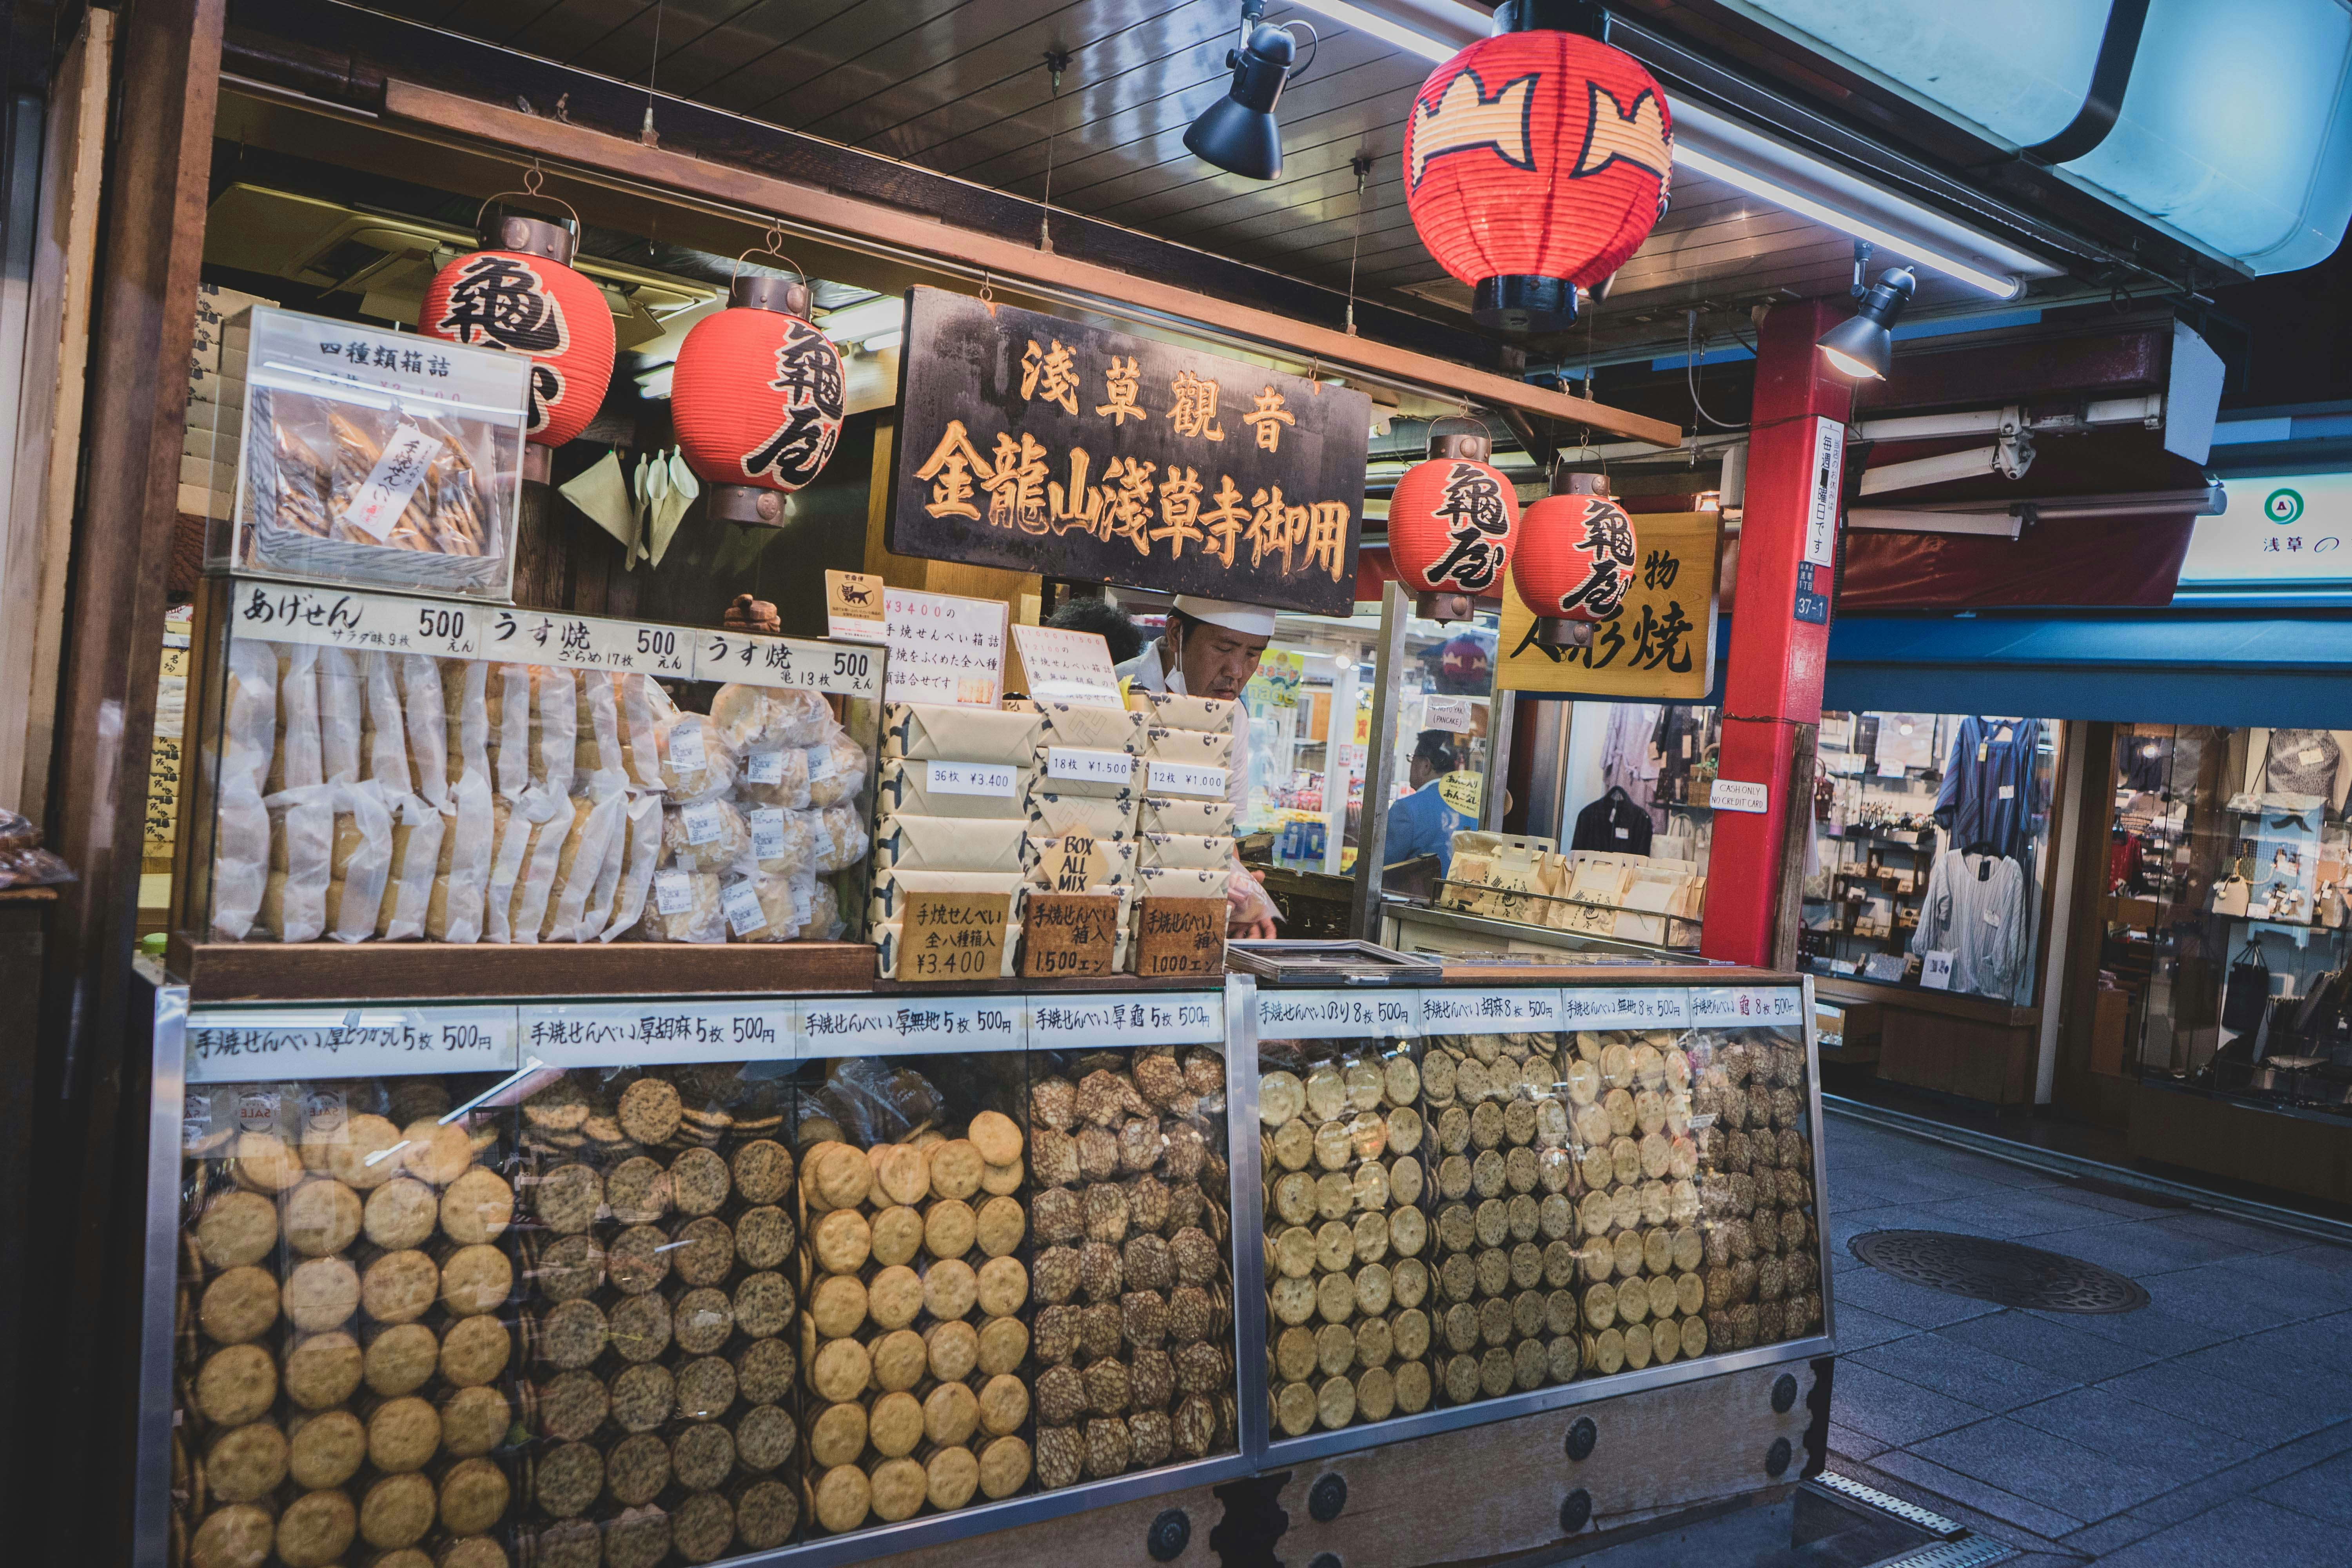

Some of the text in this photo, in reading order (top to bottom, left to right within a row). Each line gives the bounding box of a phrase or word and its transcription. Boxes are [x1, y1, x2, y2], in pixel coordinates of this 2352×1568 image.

[320, 341, 451, 377] 四種類箱詰
[914, 419, 1350, 583] 金龍山淺草寺御用
[1799, 580, 1813, 591] 1丁目
[243, 588, 464, 638] あげせん 500
[886, 600, 955, 618] ¥3400の
[1798, 597, 1823, 617] 37-1
[494, 613, 675, 657] うす焼 500
[886, 623, 1000, 648] 手焼せんべい箱詰
[446, 639, 475, 653] えん
[657, 654, 682, 670] えん
[709, 636, 869, 677] うす焼 500
[1029, 656, 1112, 674] 手焼せんべい箱詰
[852, 677, 873, 690] えん
[1433, 714, 1462, 727] (PANCAKE)
[1054, 758, 1078, 770] 18枚
[935, 770, 960, 782] 36枚
[1154, 772, 1176, 784] 12枚
[1720, 784, 1760, 796] CASH ONLY
[1722, 797, 1747, 806] CREDIT
[1748, 799, 1763, 808] CARD
[1064, 836, 1095, 856] BOX
[1060, 857, 1088, 875] ALL
[1058, 875, 1088, 892] MIX
[916, 903, 1001, 926] 手焼せんべい
[1033, 903, 1116, 928] 手焼せんべい
[1146, 909, 1212, 935] 手焼せんべい
[925, 929, 996, 948] 全八種箱入
[1071, 925, 1110, 945] 箱入
[1378, 1002, 1408, 1024] 500円
[1529, 1000, 1553, 1018] 500円
[1657, 1000, 1680, 1017] 500円
[1774, 998, 1794, 1015] 500円
[977, 1010, 1011, 1034] 500円
[1179, 1006, 1210, 1029] 500円
[443, 1025, 492, 1051] 500円
[733, 1017, 775, 1044] 500円
